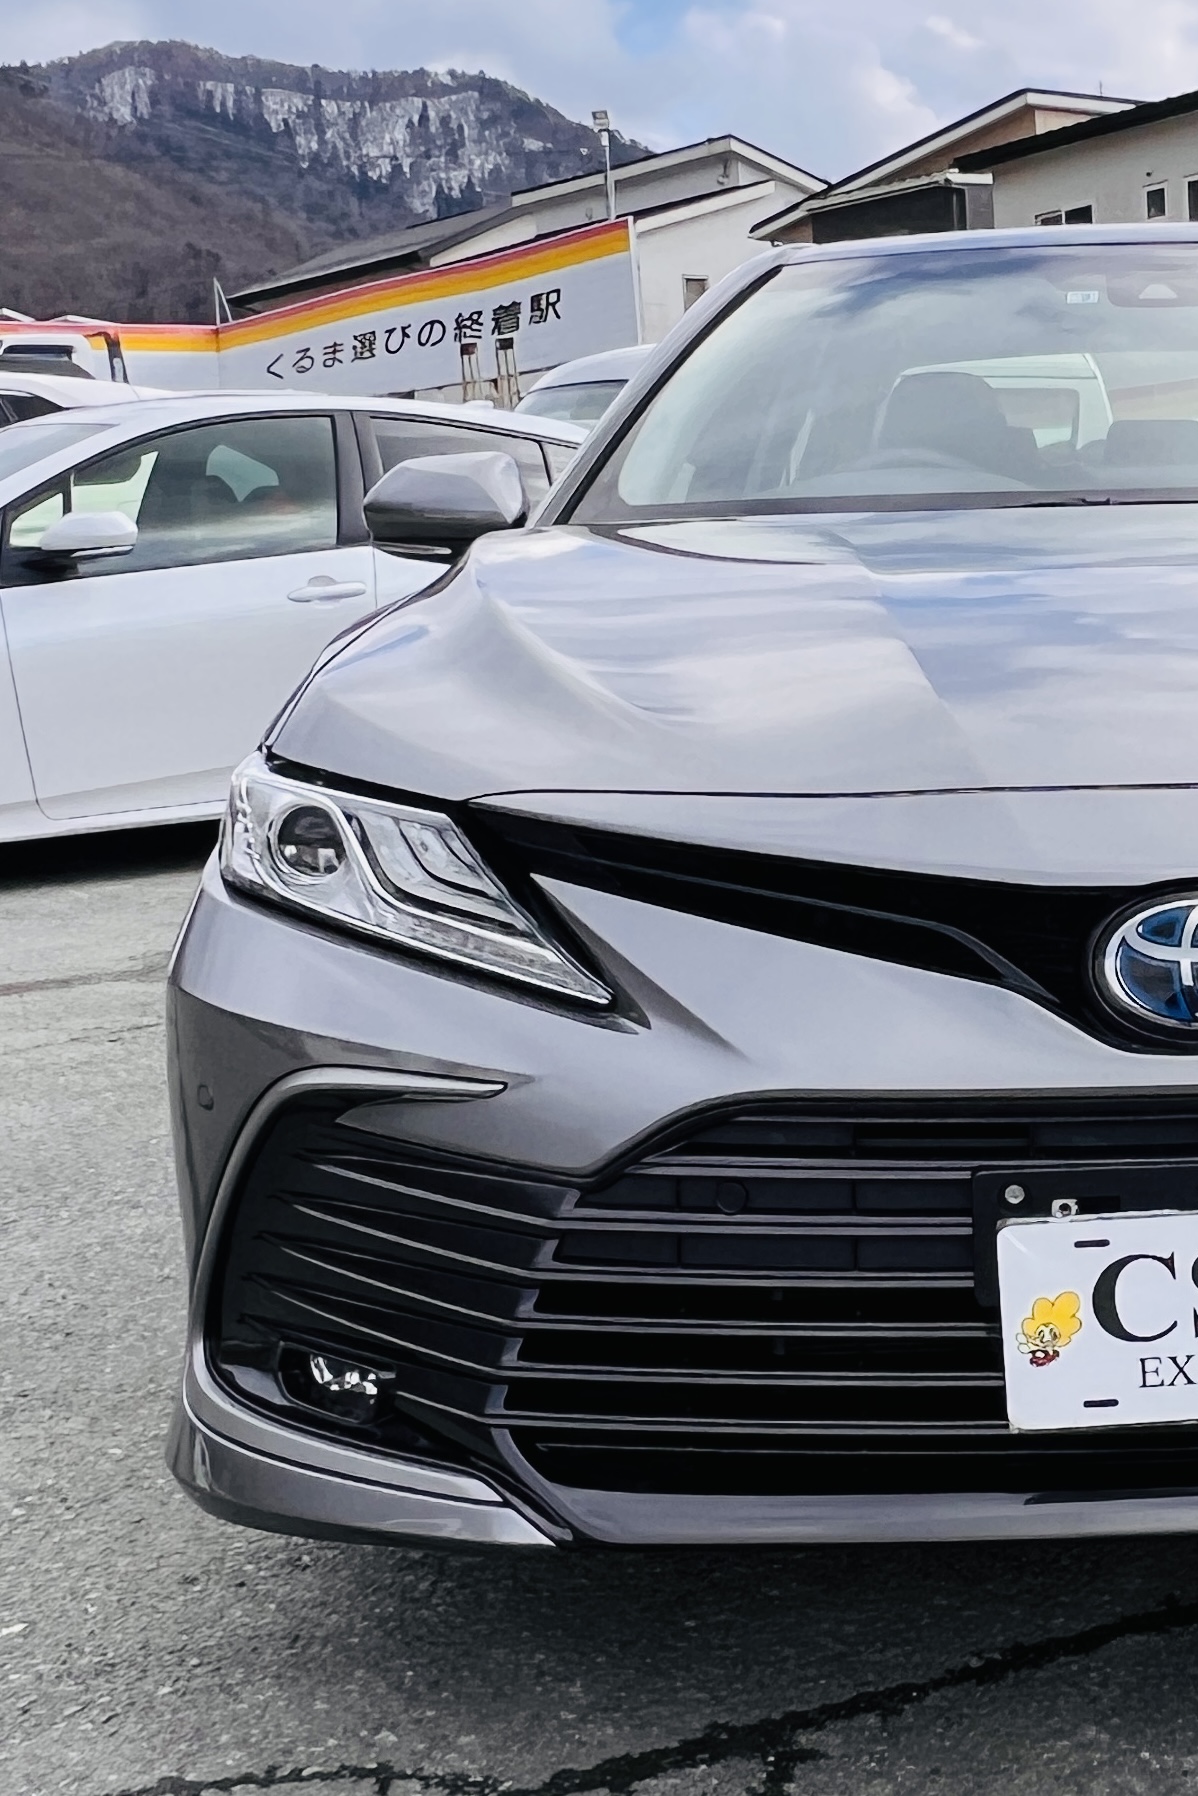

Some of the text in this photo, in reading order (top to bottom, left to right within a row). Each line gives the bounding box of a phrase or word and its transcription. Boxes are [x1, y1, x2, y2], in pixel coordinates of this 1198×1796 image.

[266, 288, 562, 380] くるま選びの終着駅
